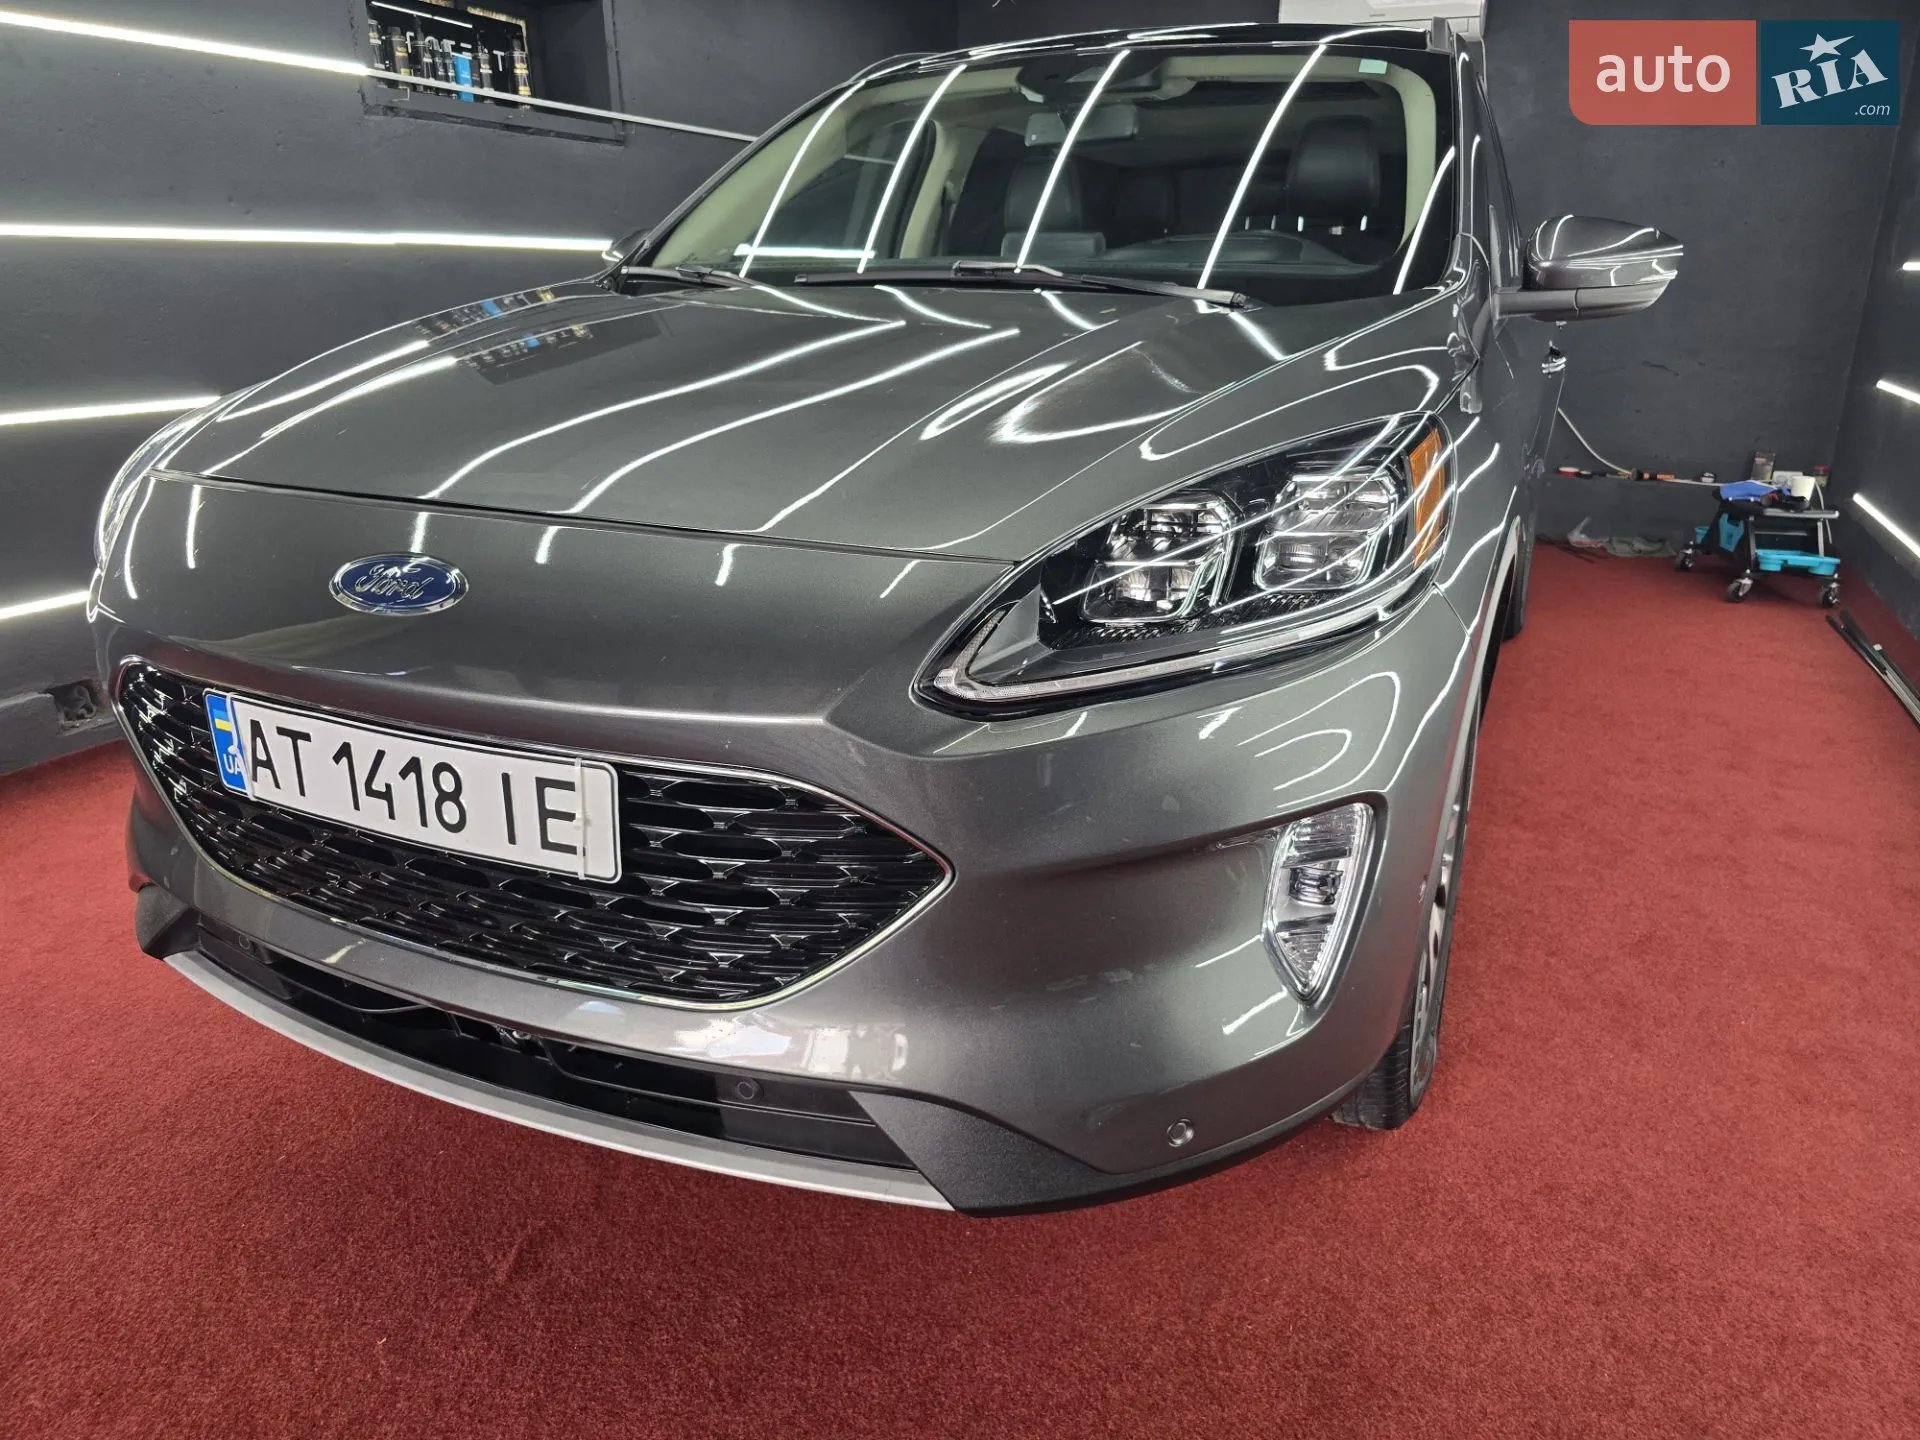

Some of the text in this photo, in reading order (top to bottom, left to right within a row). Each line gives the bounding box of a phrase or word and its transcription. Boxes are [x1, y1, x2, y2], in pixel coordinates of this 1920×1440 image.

[355, 564, 435, 600] Ford
[250, 718, 586, 857] AT 1418 IE
